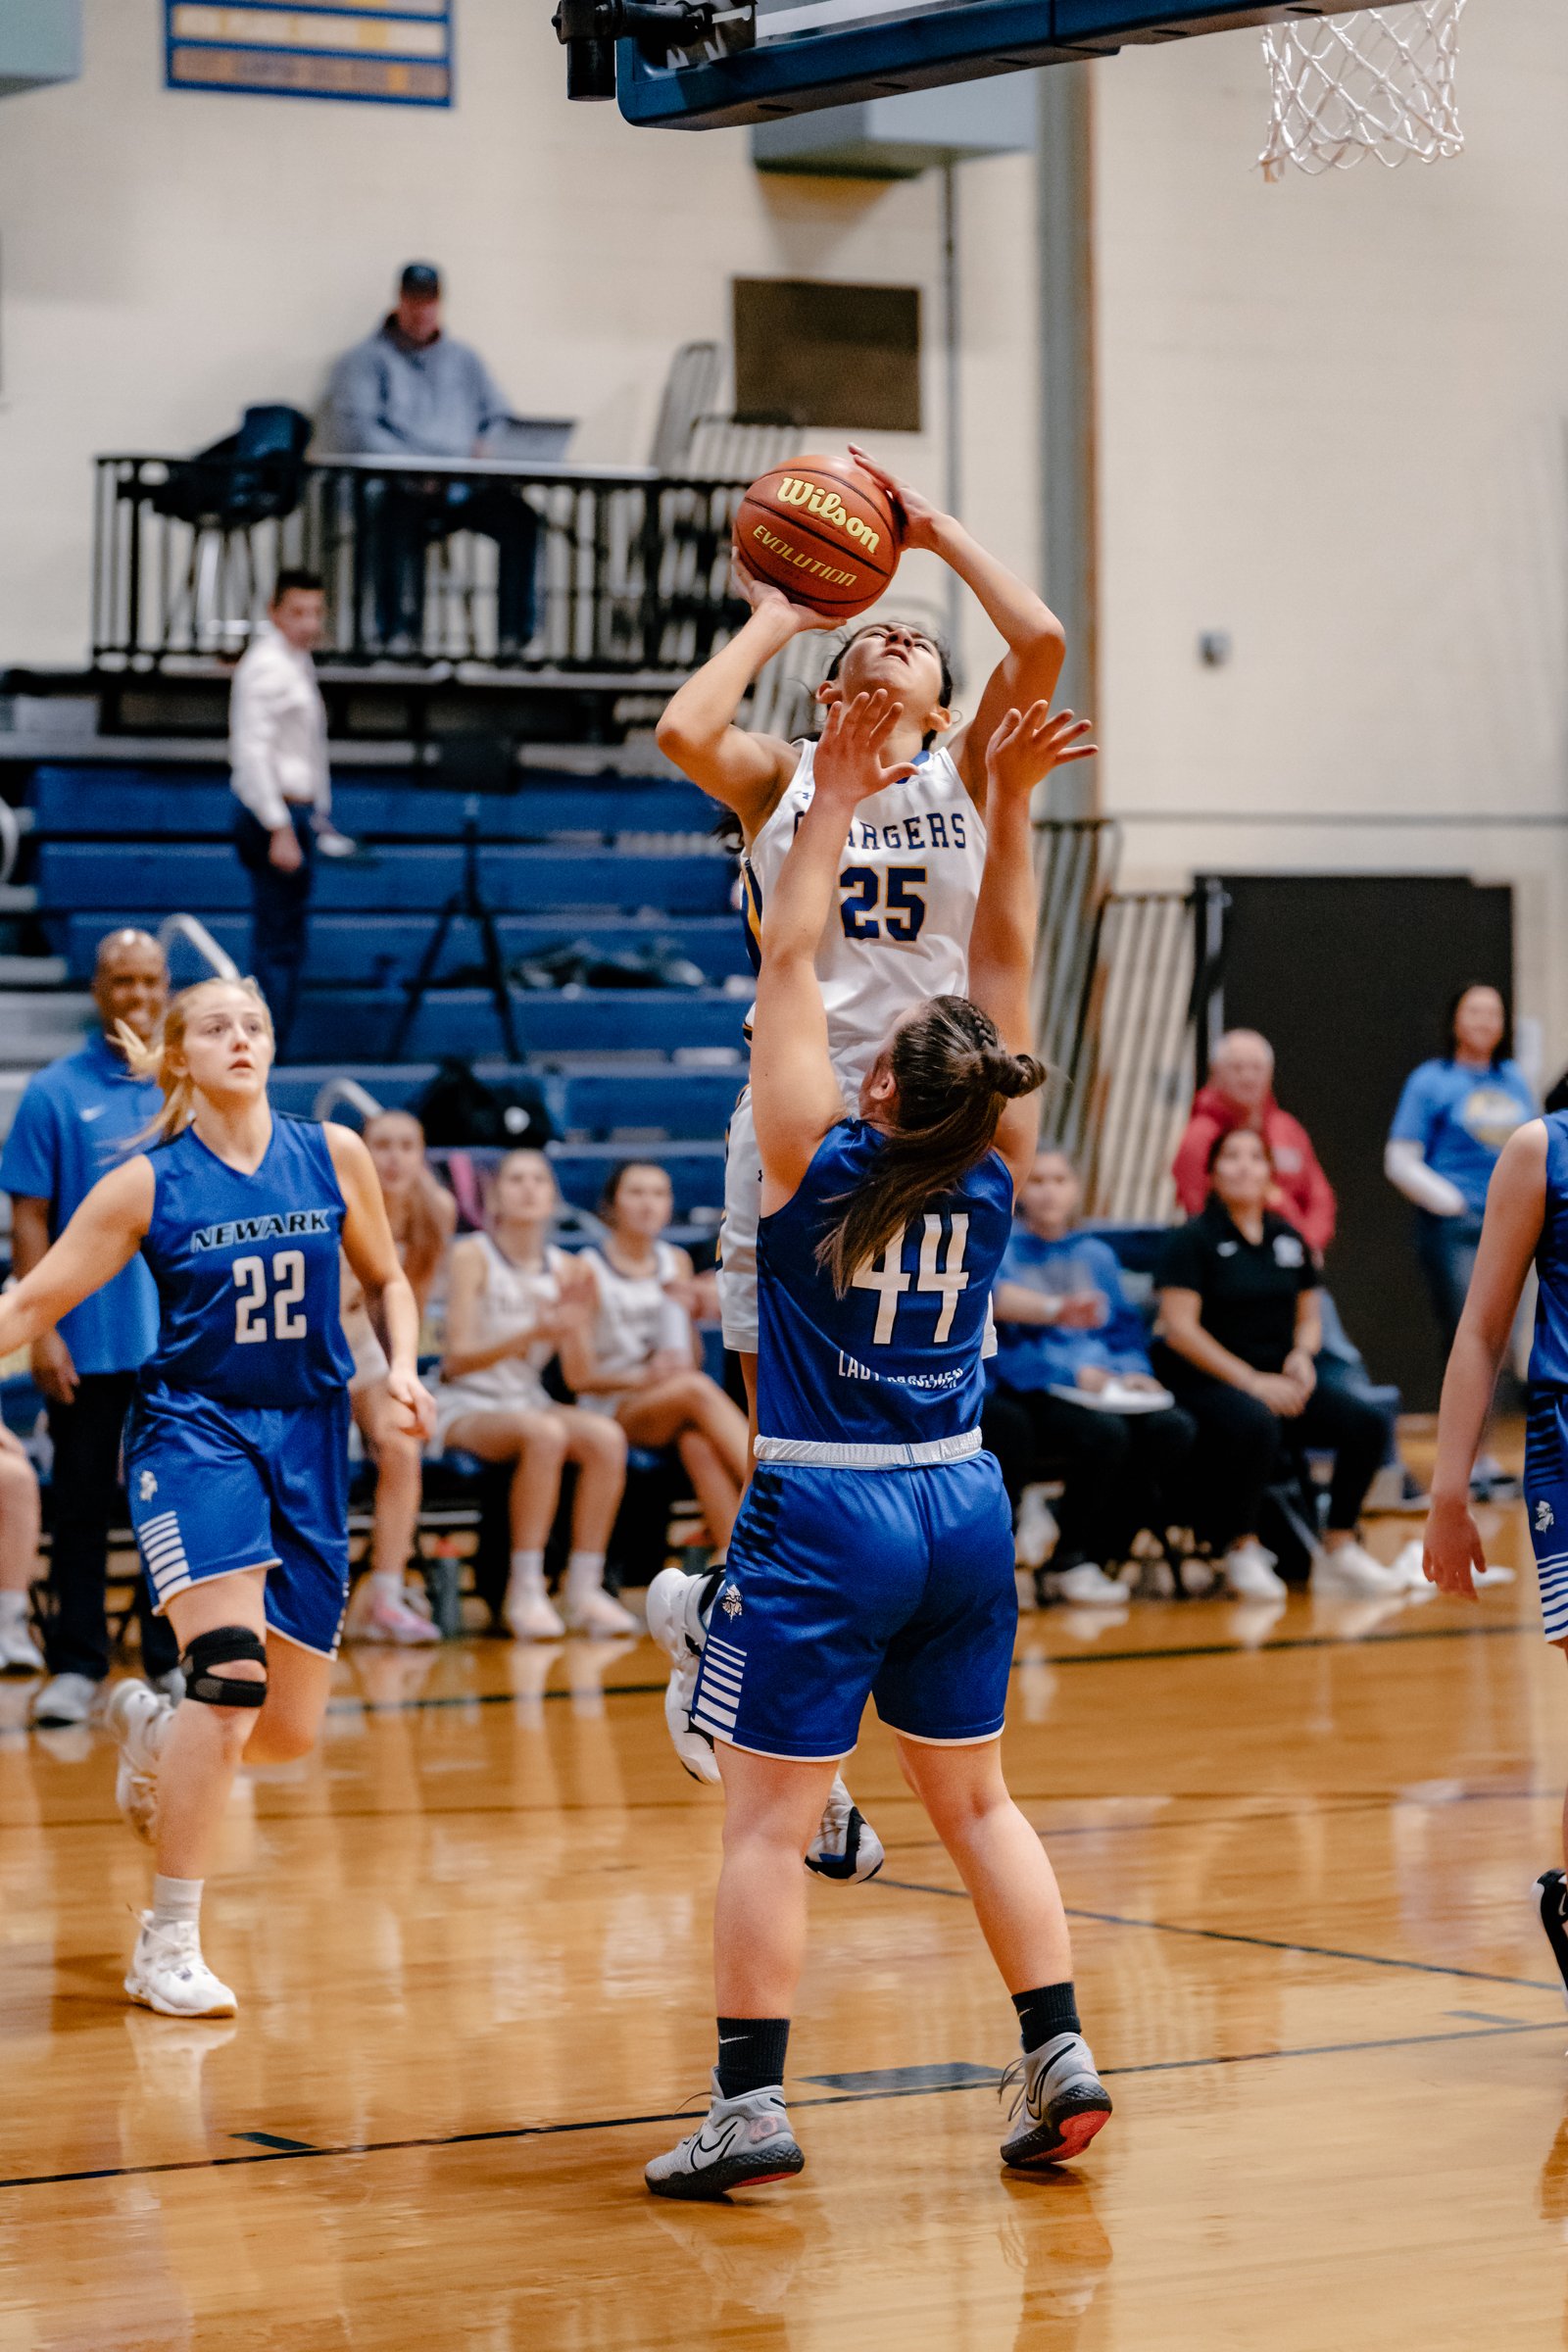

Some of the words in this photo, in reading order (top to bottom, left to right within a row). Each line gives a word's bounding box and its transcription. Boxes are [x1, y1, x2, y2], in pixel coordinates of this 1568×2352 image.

[776, 476, 880, 554] Wilson
[753, 524, 858, 587] EVOLUTION
[794, 810, 966, 850] RGERS
[838, 864, 928, 944] 25
[190, 1209, 330, 1253] NEWARK
[232, 1250, 307, 1345] 22
[852, 1213, 969, 1345] 44
